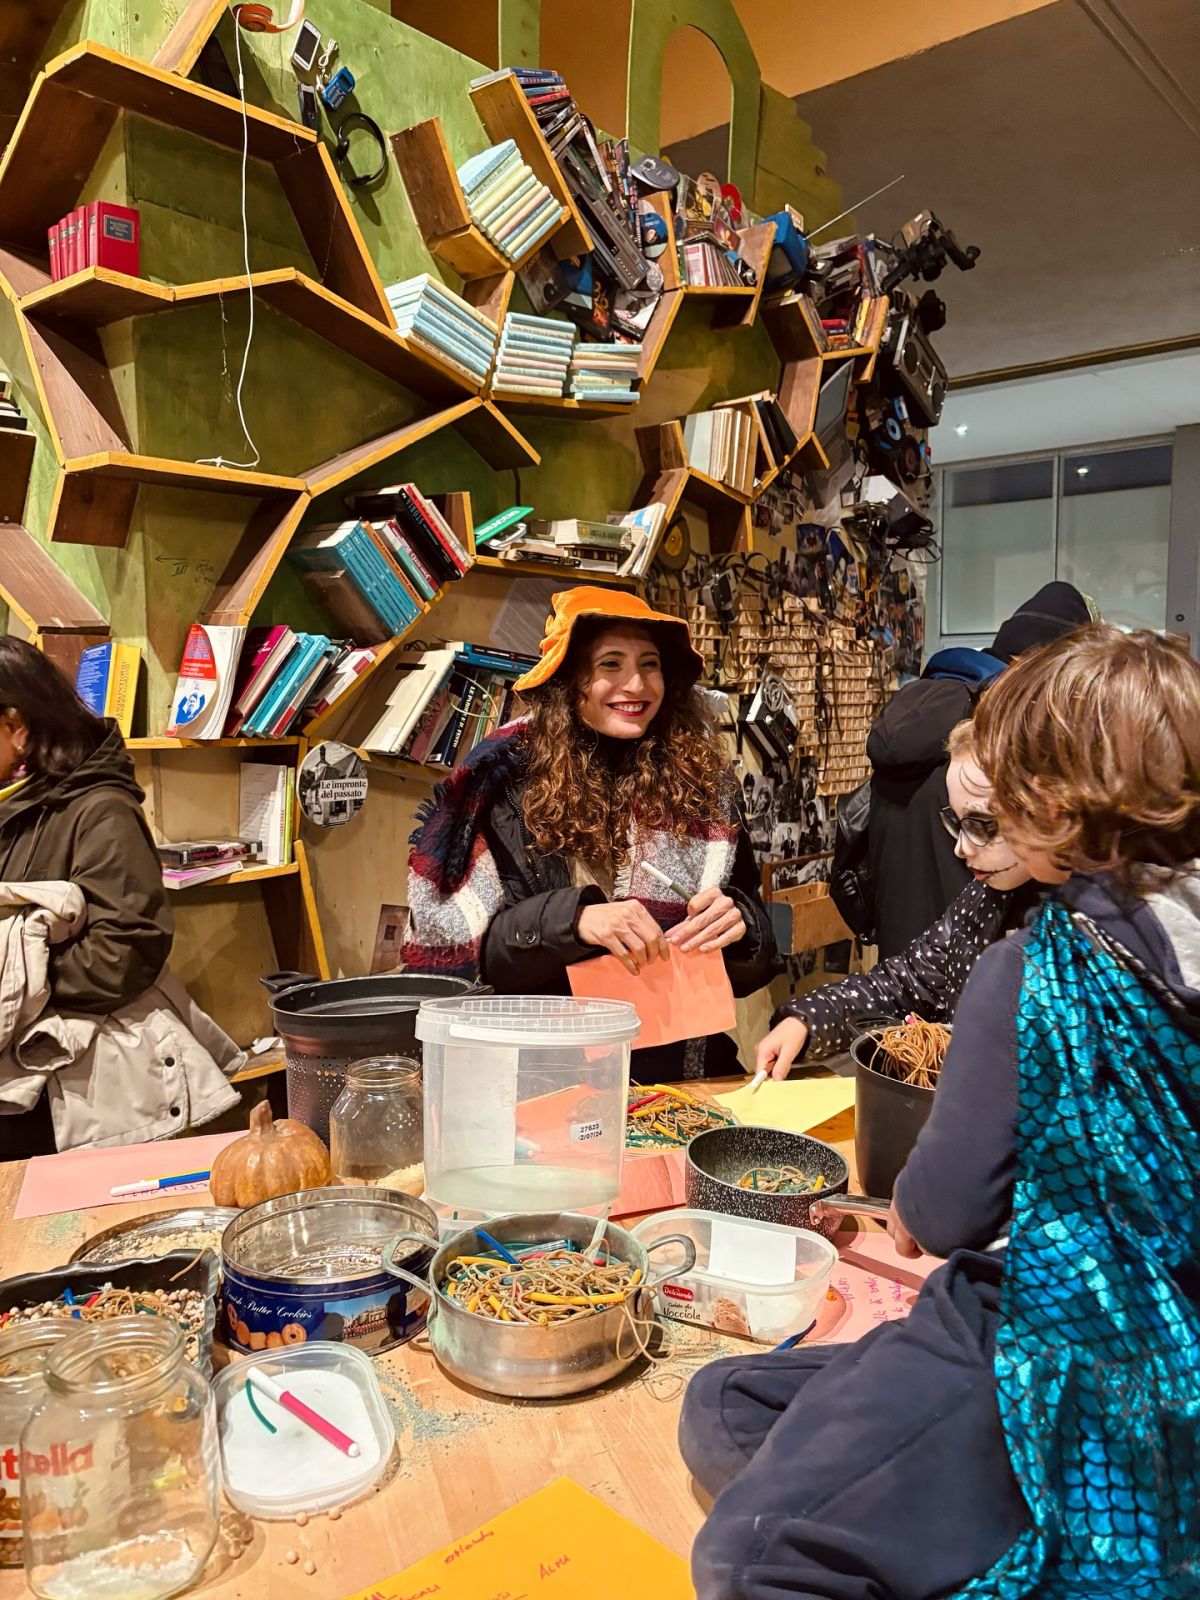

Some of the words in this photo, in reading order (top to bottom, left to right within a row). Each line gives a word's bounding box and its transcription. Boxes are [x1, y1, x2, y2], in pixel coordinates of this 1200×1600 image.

[321, 781, 331, 789] Le
[331, 780, 367, 790] impronte
[320, 789, 333, 799] del
[333, 789, 362, 800] passato
[246, 1300, 273, 1315] Butter
[276, 1306, 312, 1319] Cookies
[663, 1307, 702, 1320] Nocciola
